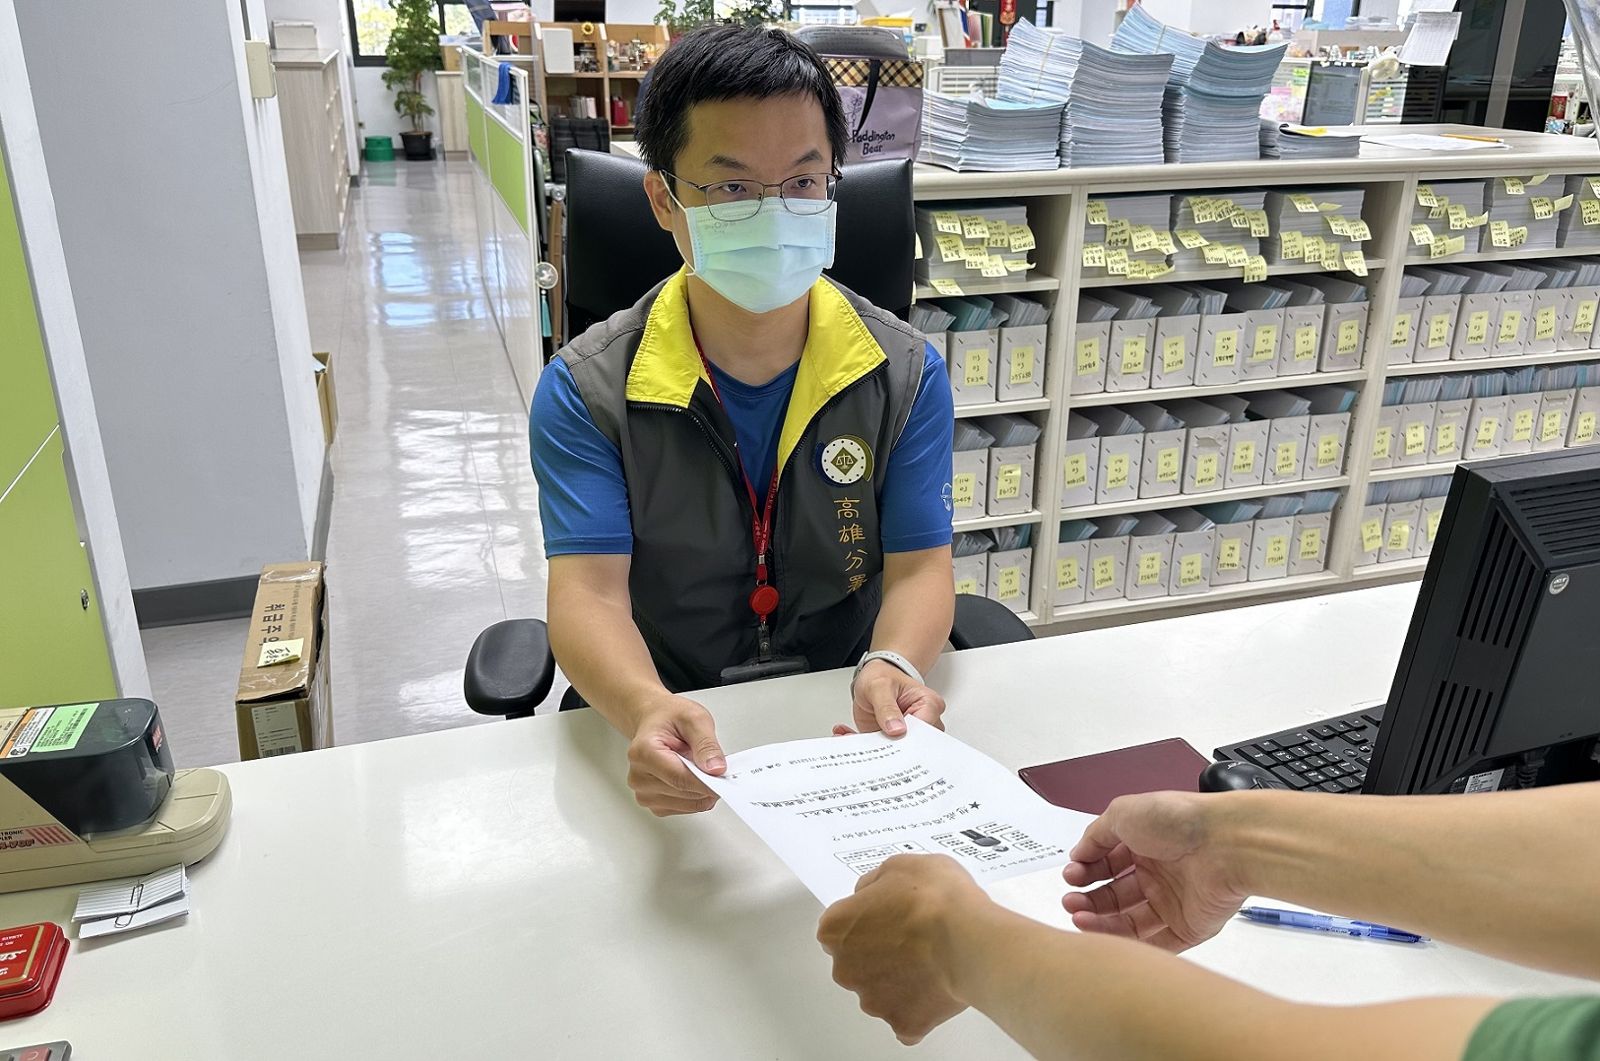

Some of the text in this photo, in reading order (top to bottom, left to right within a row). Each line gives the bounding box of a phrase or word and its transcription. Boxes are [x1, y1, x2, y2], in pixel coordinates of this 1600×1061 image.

[852, 130, 895, 144] Paddington
[862, 143, 882, 155] Bear
[834, 497, 867, 593] 高雄分署
